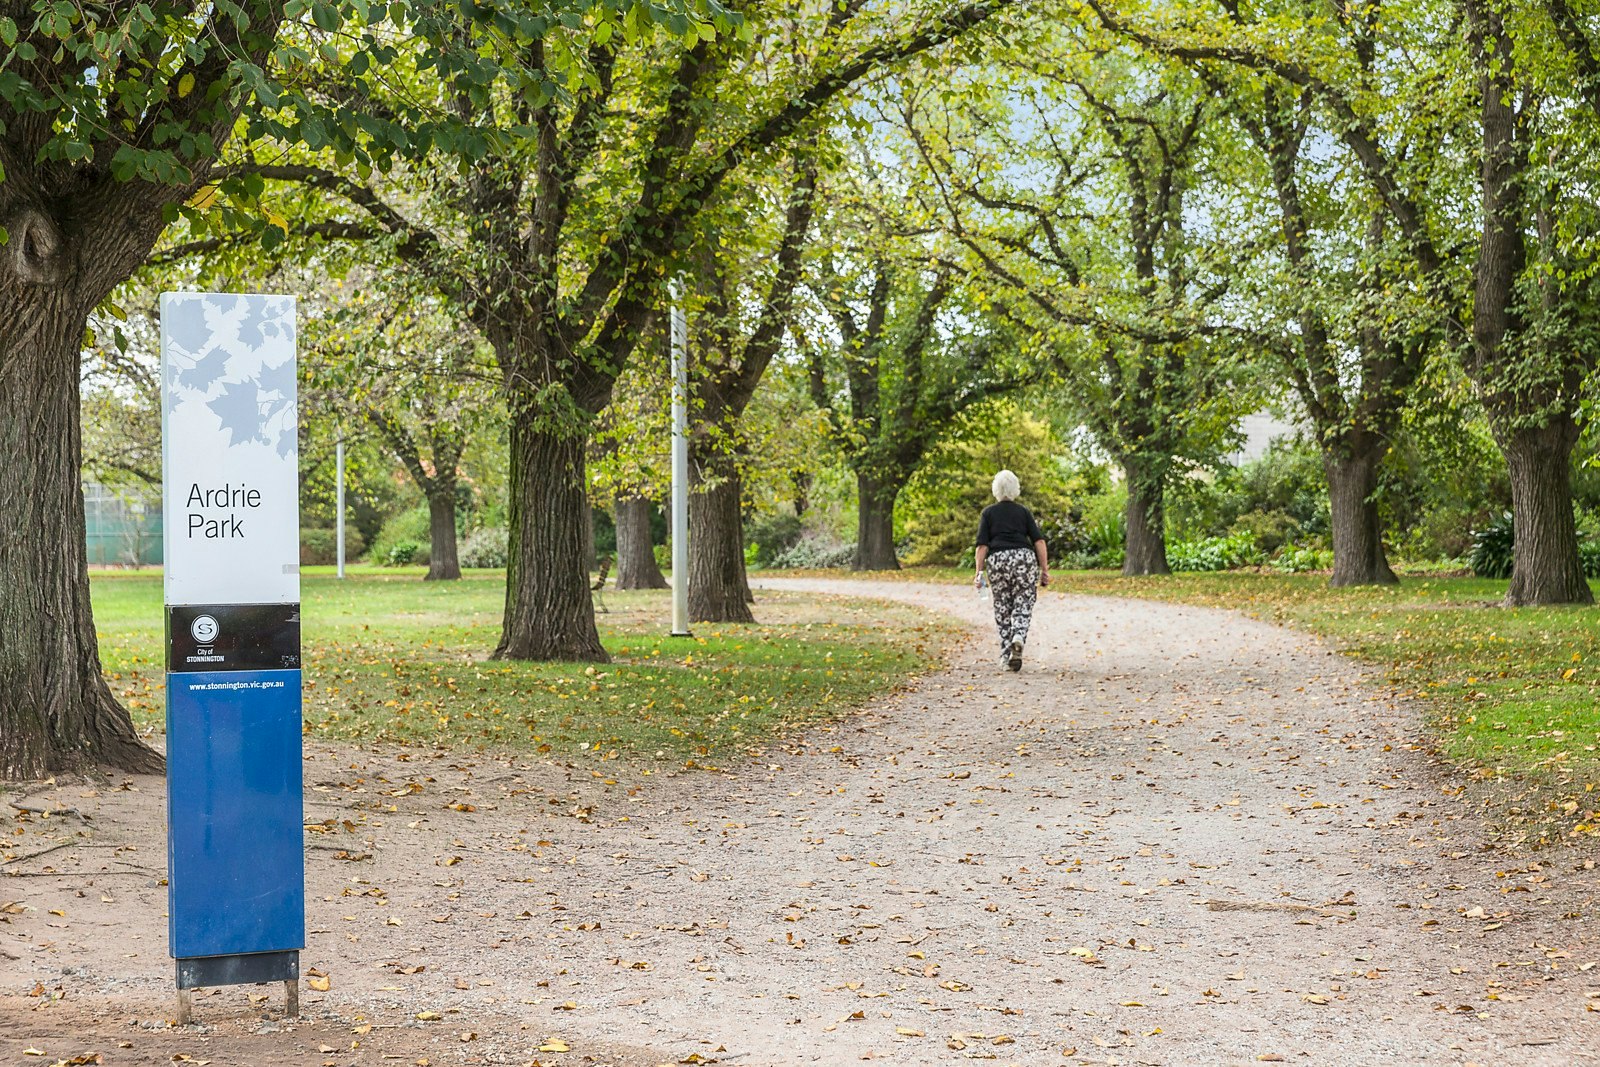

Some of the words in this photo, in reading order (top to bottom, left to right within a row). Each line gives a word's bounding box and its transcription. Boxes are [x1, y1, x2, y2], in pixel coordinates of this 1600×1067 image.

[186, 483, 261, 508] Ardrie
[188, 513, 245, 539] Park
[198, 623, 213, 635] S
[189, 680, 285, 691] www.stonnington.vic.gov.au
